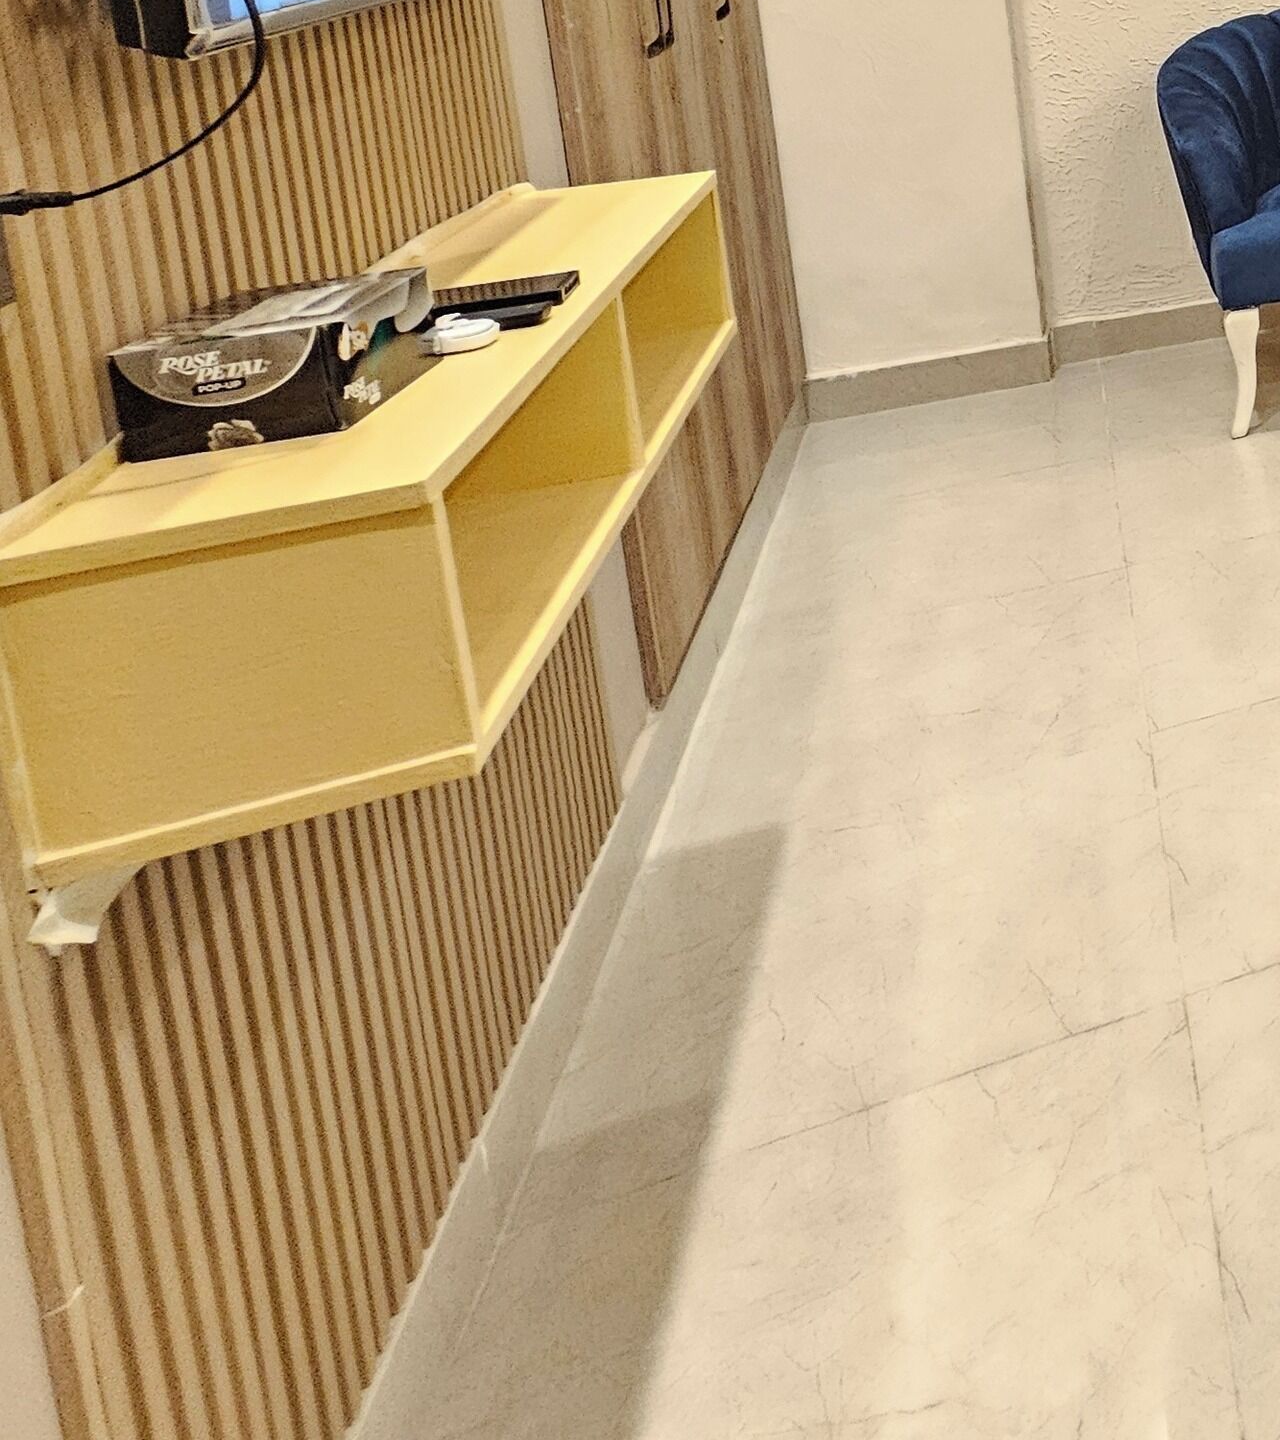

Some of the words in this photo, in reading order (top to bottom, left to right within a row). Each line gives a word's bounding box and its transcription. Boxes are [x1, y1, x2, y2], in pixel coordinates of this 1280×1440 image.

[158, 350, 221, 376] ROSE
[195, 358, 268, 383] PETAL
[198, 380, 242, 394] POP-UP
